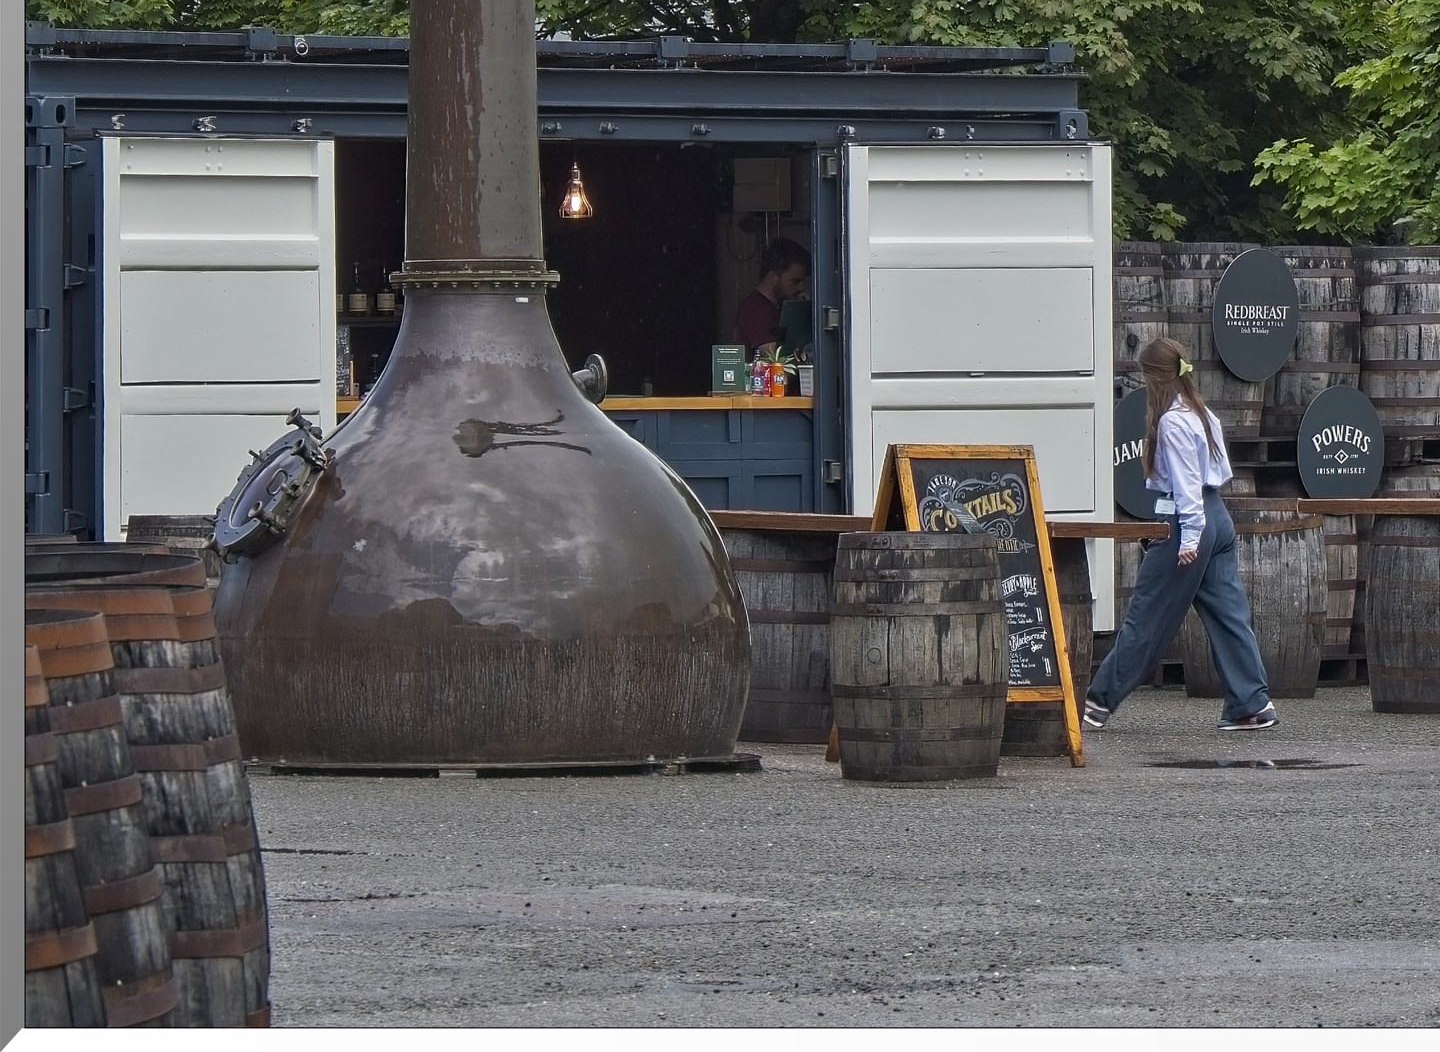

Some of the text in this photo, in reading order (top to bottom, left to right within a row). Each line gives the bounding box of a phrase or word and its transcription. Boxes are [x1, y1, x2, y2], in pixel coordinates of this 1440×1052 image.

[1225, 303, 1291, 320] REDBREAST
[1113, 438, 1148, 467] JAM
[1311, 424, 1371, 453] POWERS
[1316, 467, 1366, 475] IRISH WHISKEY
[930, 489, 1017, 531] COKTAILS
